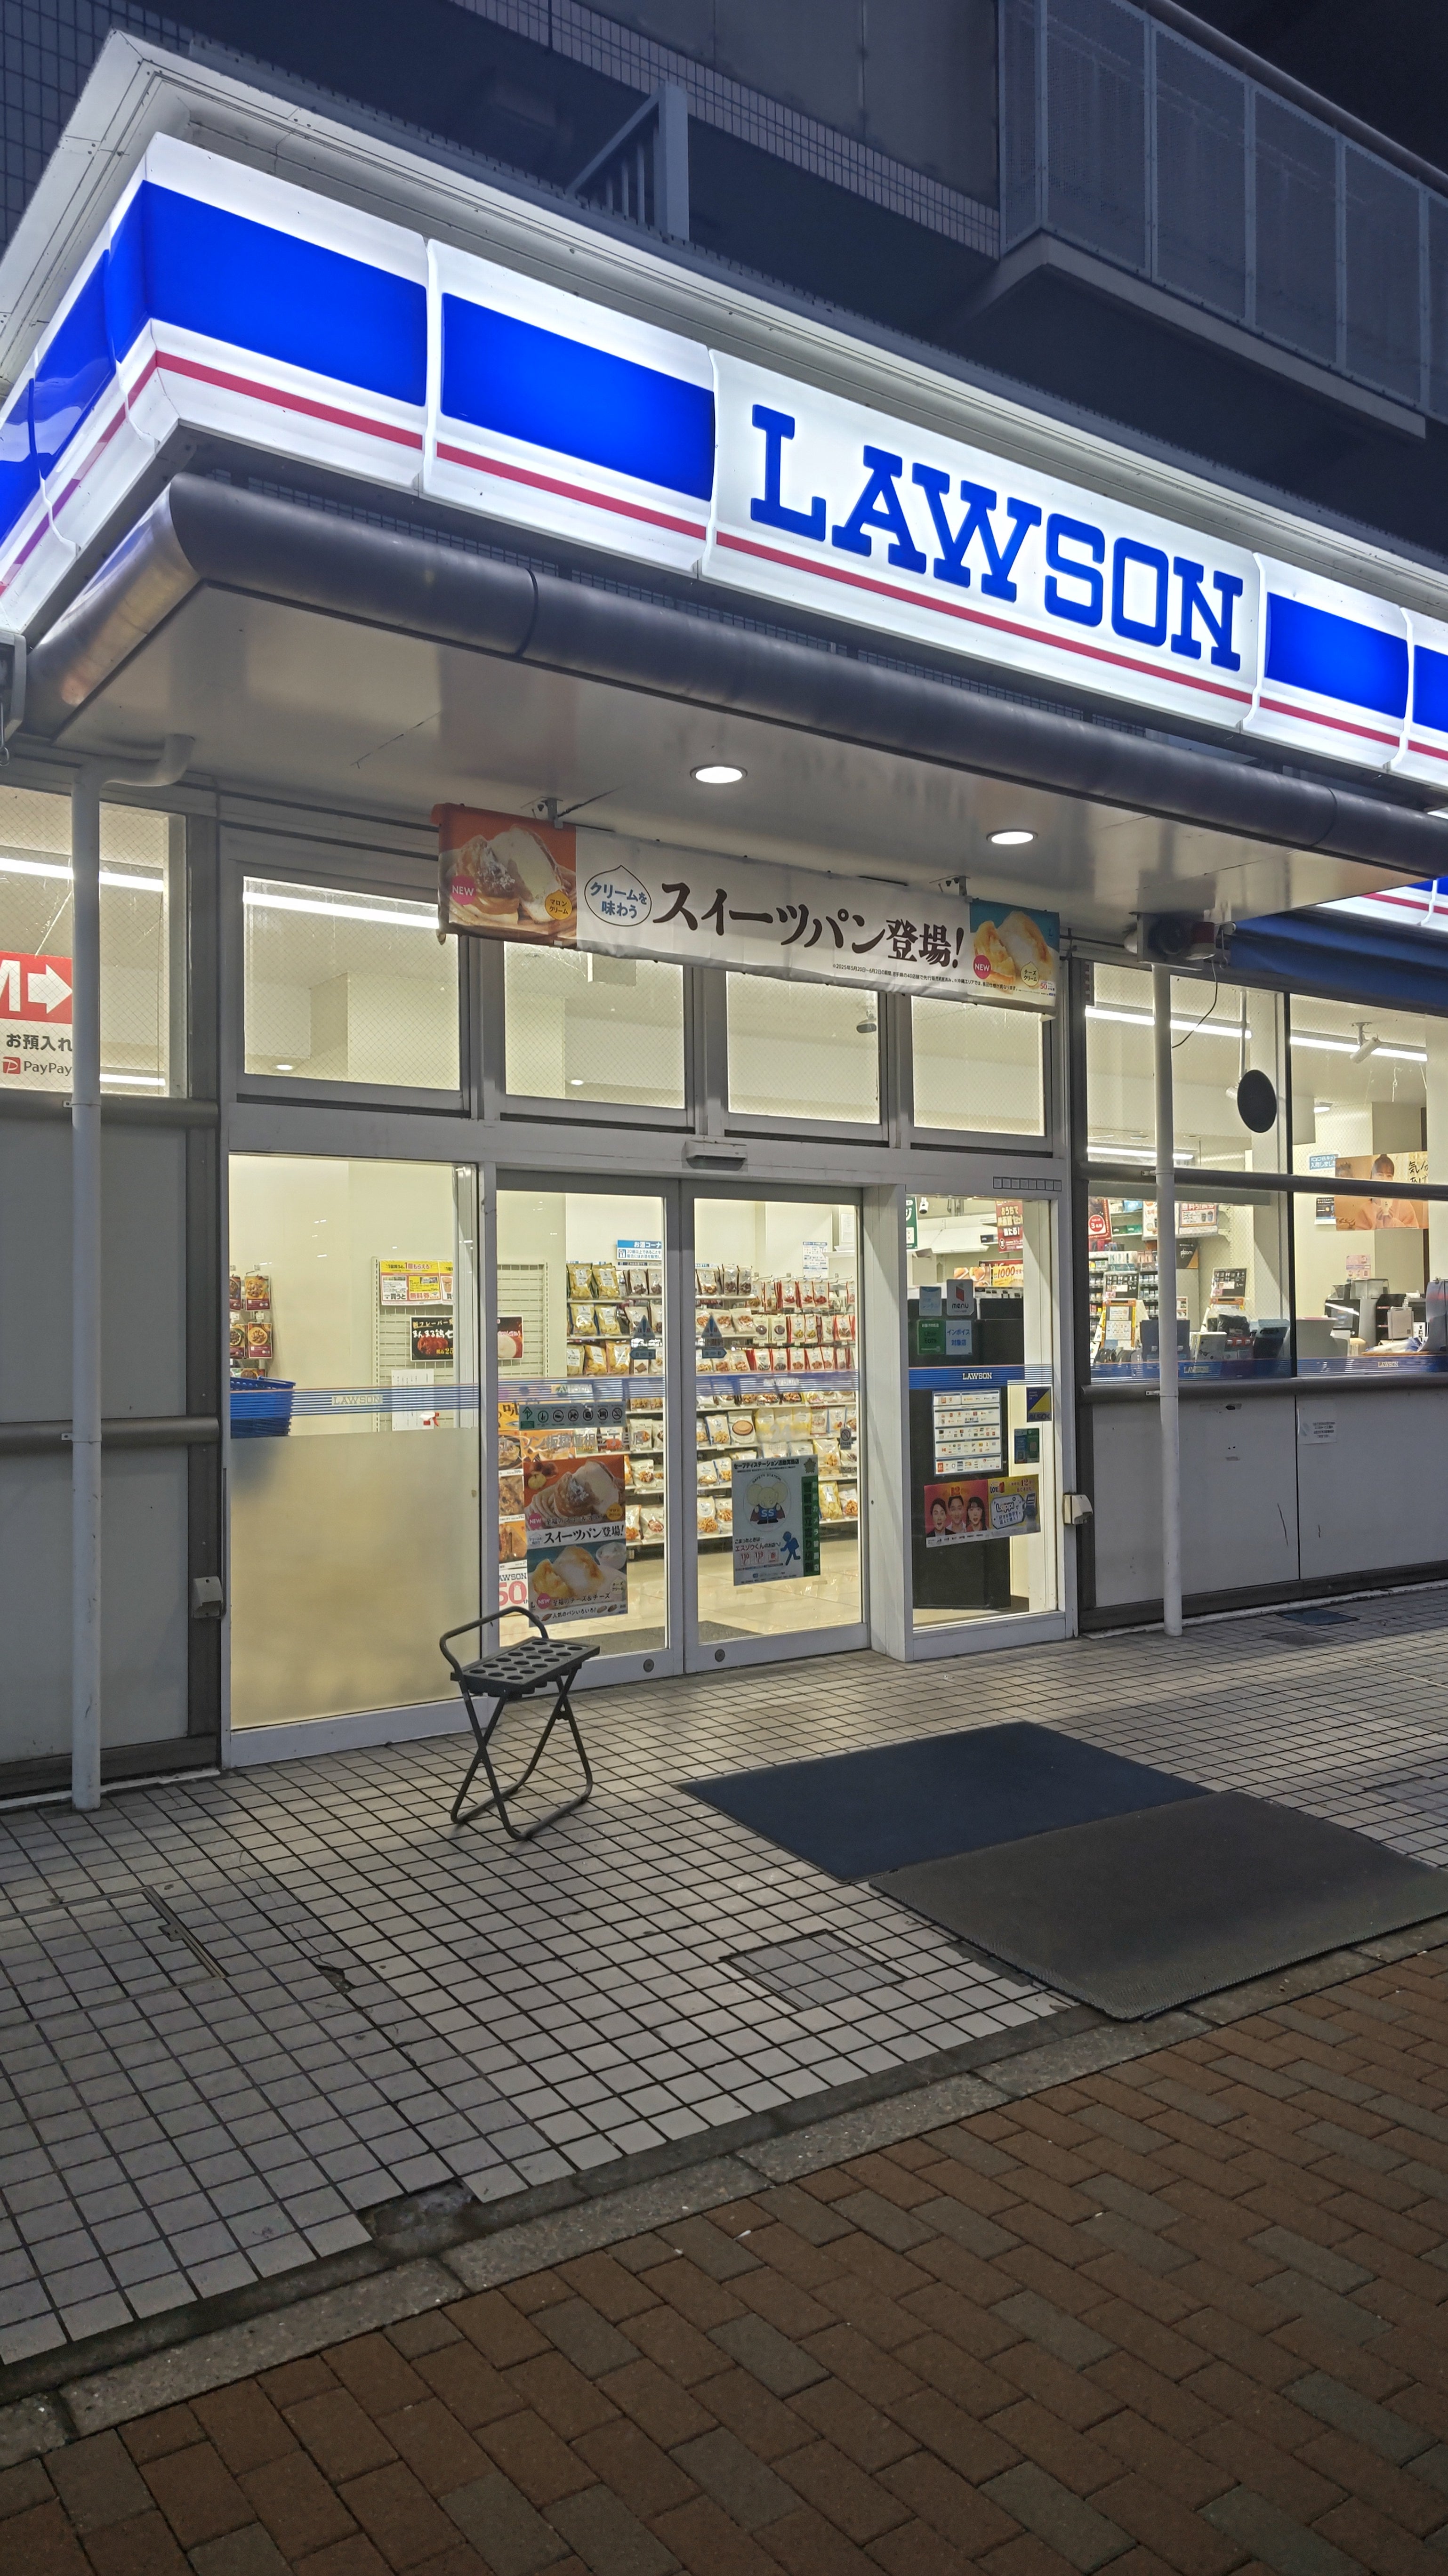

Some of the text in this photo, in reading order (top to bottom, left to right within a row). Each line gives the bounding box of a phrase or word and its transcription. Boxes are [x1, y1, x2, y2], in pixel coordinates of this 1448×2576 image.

[751, 404, 1243, 672] LAWSON
[452, 885, 474, 896] NEW
[590, 882, 647, 905] クリームを
[550, 898, 567, 907] マロン
[549, 905, 569, 915] クリーム
[601, 901, 637, 918] 味わう
[653, 882, 965, 968] スイーツパン登場!
[974, 963, 989, 972] NEW
[6, 1033, 72, 1052] お預入れ
[24, 1061, 72, 1076] PayPay
[1180, 1248, 1193, 1258] ploom
[333, 1395, 381, 1405] LAWSON
[761, 1508, 774, 1518] SS
[544, 1525, 624, 1545] スイーツパン登場!
